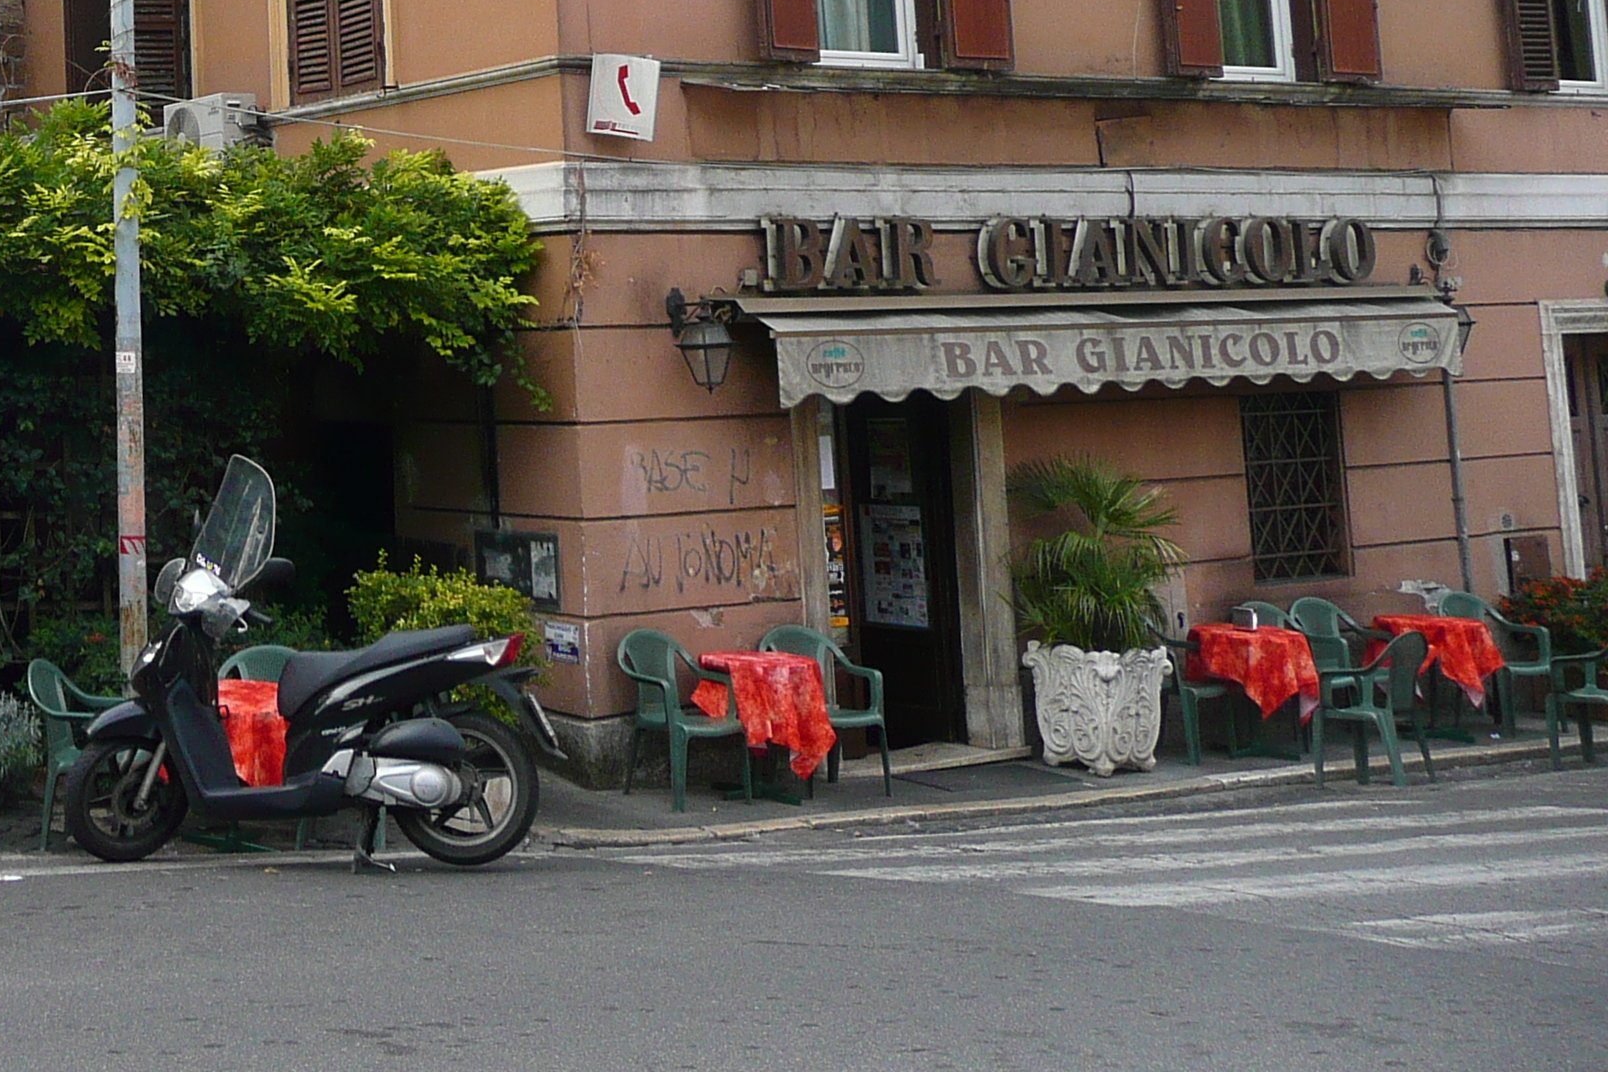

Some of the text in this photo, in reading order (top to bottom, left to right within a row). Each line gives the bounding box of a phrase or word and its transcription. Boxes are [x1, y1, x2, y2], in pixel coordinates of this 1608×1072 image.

[761, 215, 1377, 291] BAR GIANICOLO
[941, 329, 1340, 379] BAR GIANICOLO
[630, 448, 711, 493] BASE
